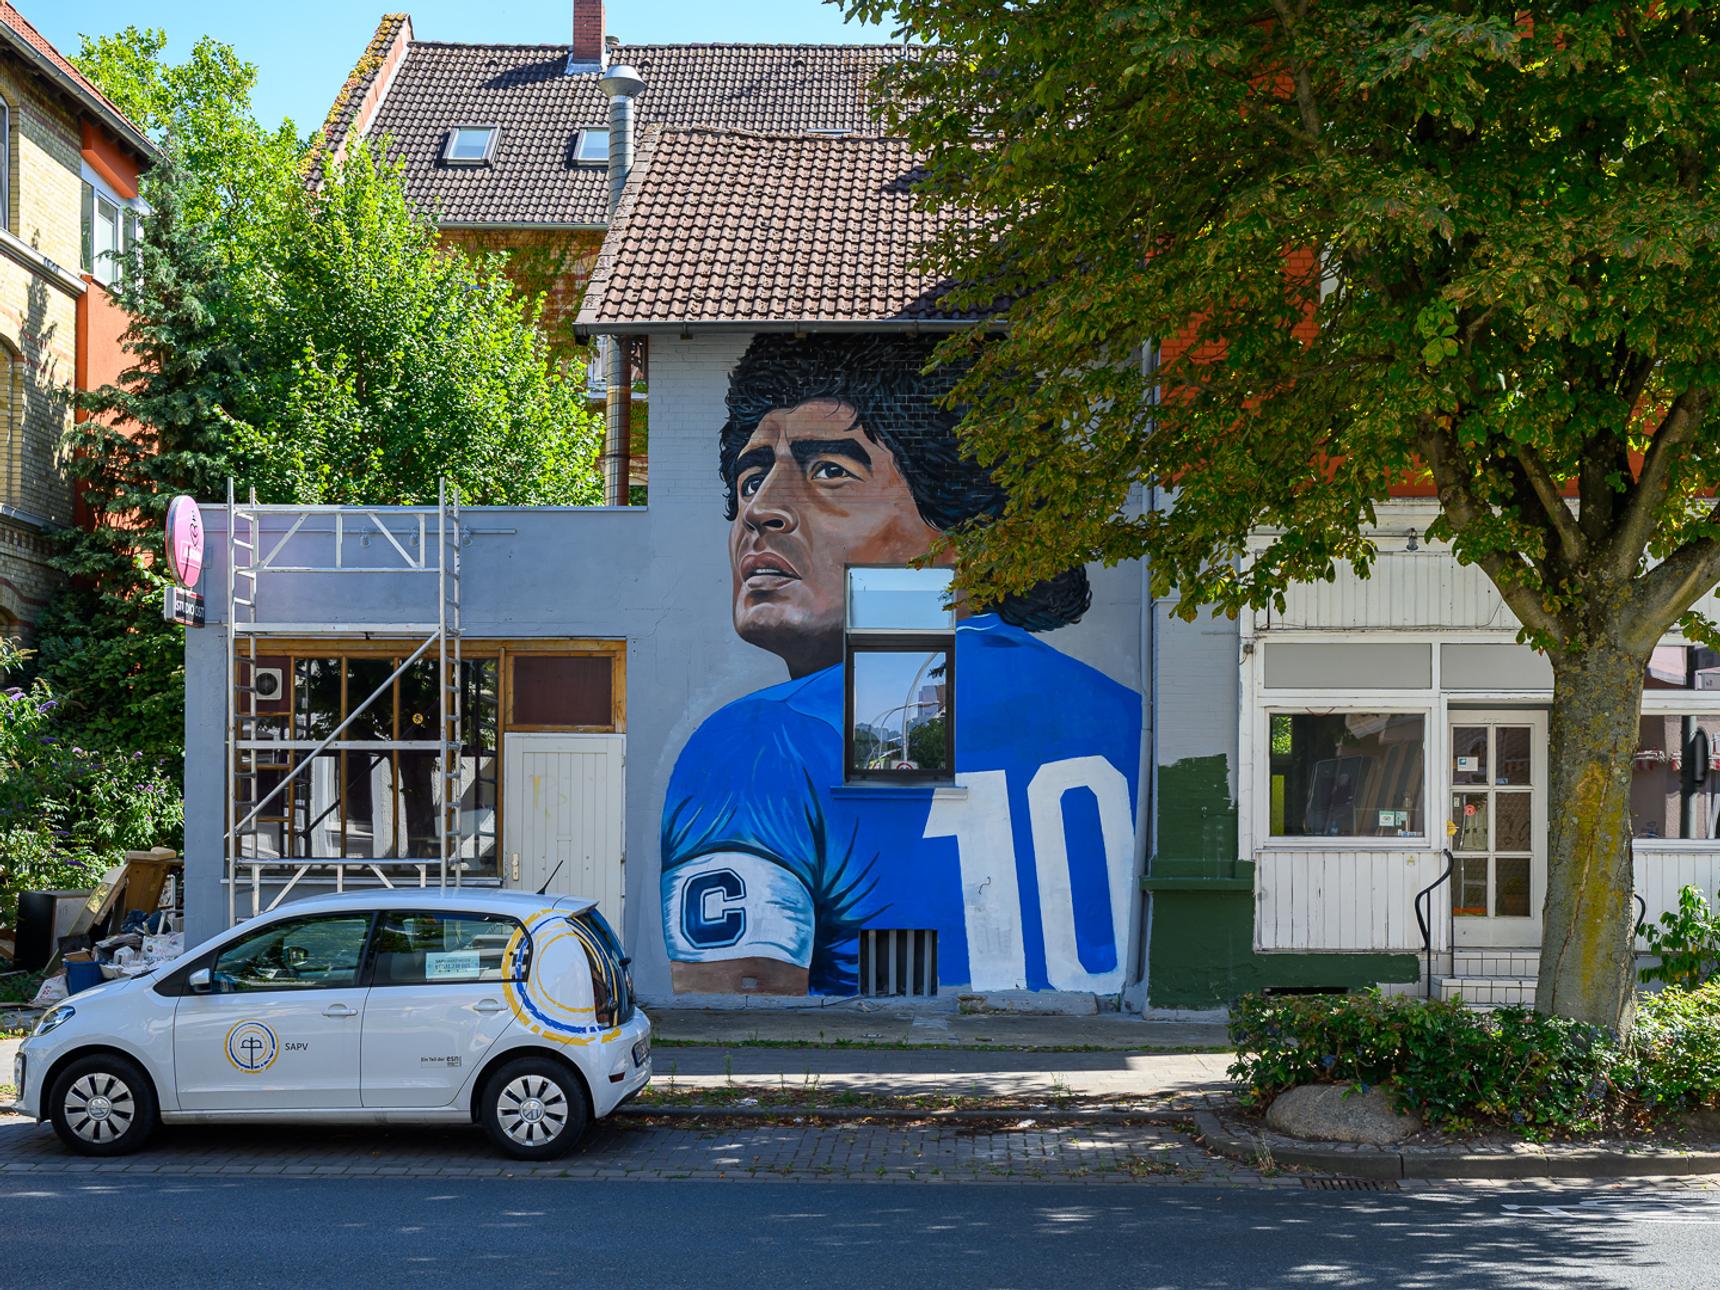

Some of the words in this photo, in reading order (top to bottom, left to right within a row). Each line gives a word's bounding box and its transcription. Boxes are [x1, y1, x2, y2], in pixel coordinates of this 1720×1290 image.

[176, 600, 195, 616] STUDIO
[922, 755, 1135, 995] 10
[680, 868, 747, 950] C
[285, 1043, 308, 1051] SAPV
